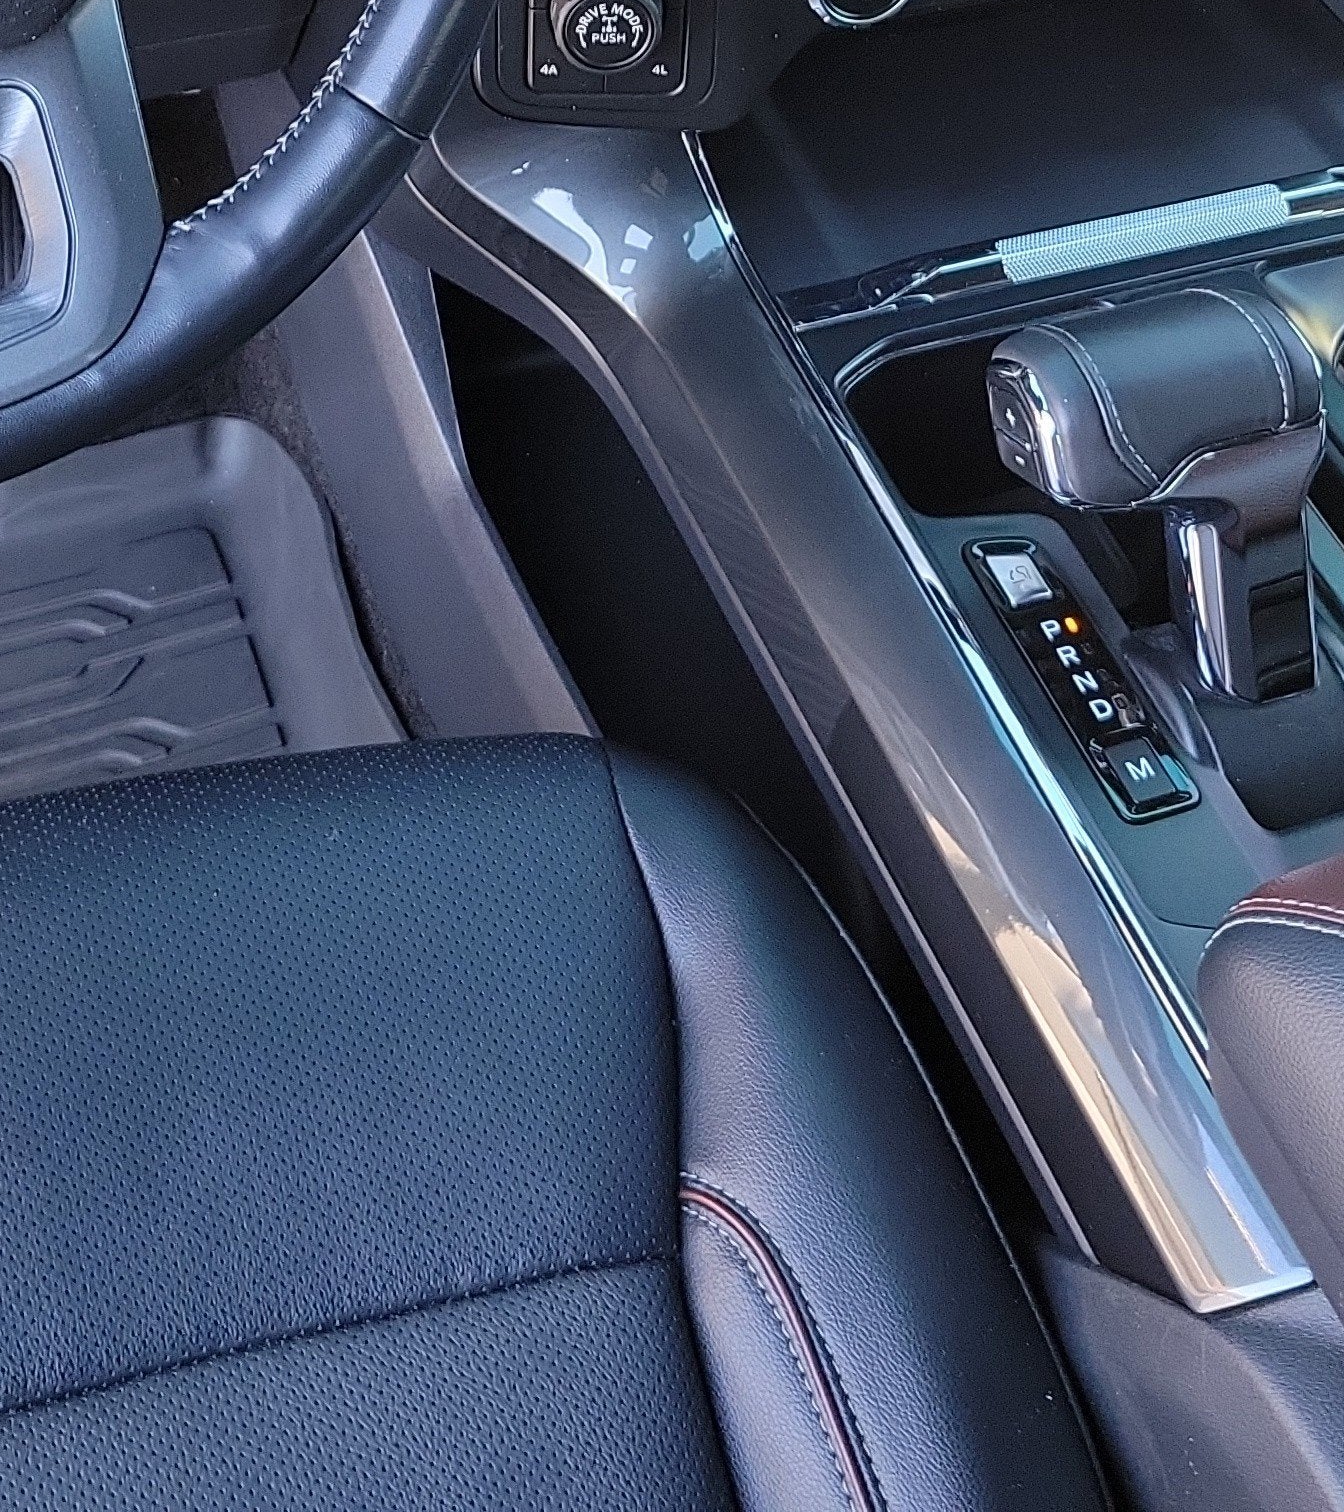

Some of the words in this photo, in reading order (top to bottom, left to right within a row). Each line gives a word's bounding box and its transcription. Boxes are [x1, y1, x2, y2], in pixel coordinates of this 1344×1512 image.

[575, 3, 607, 34] DRIVE
[610, 2, 644, 33] MODE
[591, 32, 626, 44] PUSH
[539, 64, 558, 76] 4A
[652, 64, 668, 76] 4L
[1040, 619, 1062, 642] P
[1056, 645, 1081, 668] R
[1072, 670, 1099, 695] N
[1088, 699, 1113, 722] D
[1125, 757, 1155, 781] M
